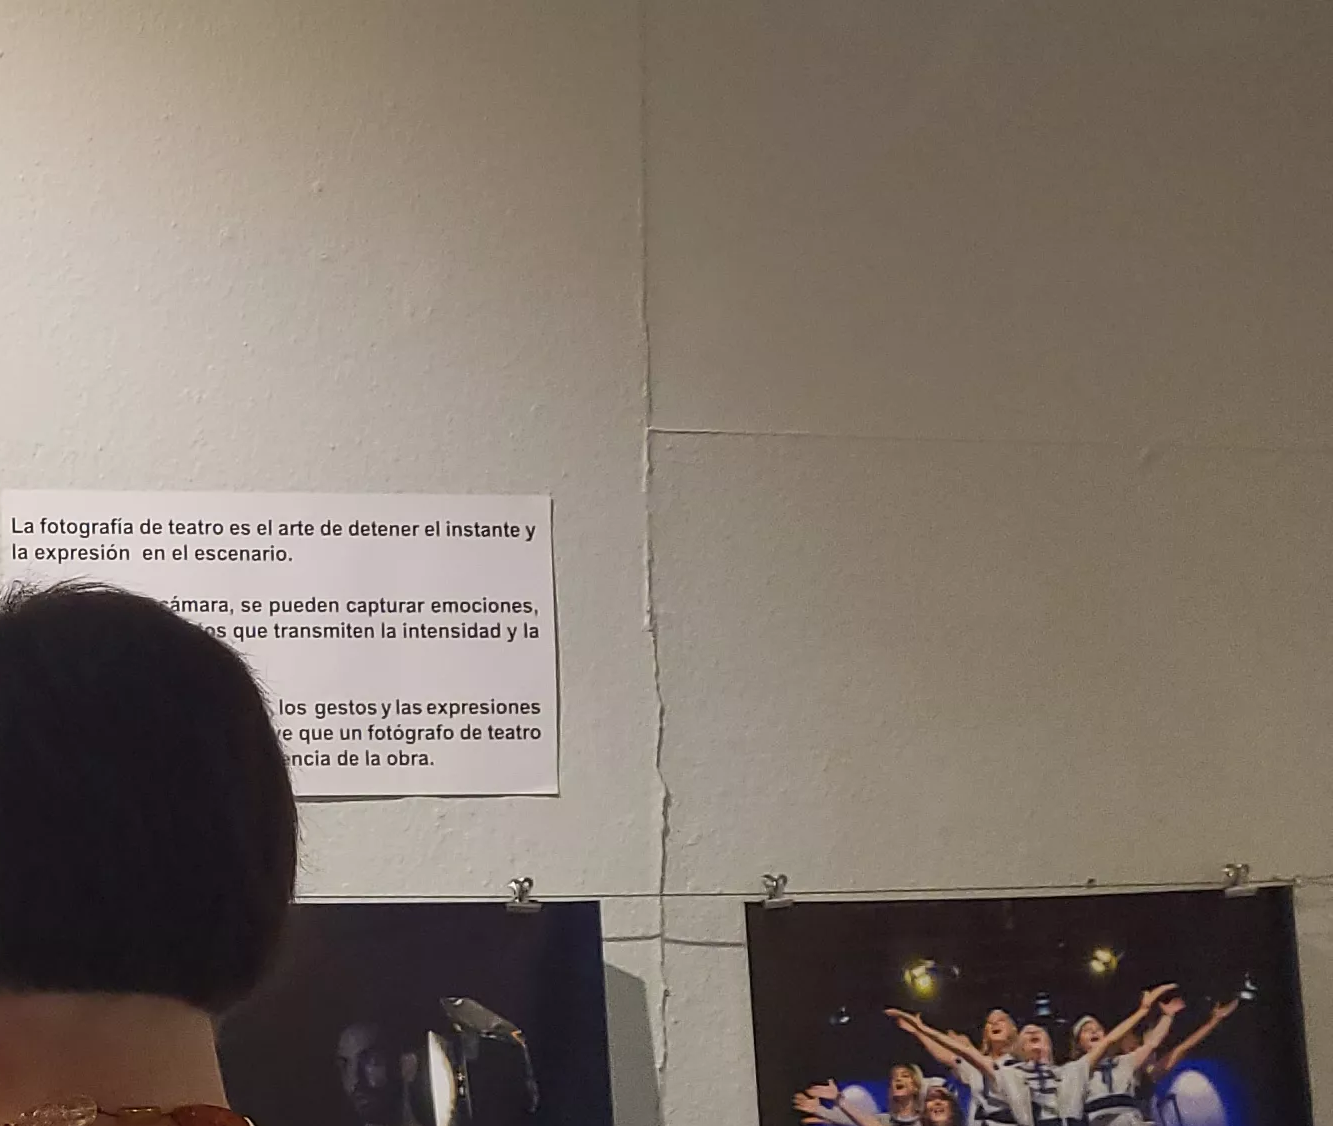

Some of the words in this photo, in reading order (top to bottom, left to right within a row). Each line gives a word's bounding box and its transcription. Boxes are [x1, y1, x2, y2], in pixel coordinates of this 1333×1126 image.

[11, 517, 35, 534] La
[39, 517, 134, 539] fotografía
[139, 518, 163, 535] de
[167, 519, 224, 536] teatro
[229, 523, 251, 536] es
[256, 519, 273, 537] el
[278, 519, 315, 537] arte
[319, 519, 343, 537] de
[348, 519, 421, 537] detener
[424, 520, 441, 538] el
[445, 520, 521, 539] instante
[524, 524, 537, 543] y
[12, 542, 29, 560] la
[34, 543, 130, 565] expresión
[142, 548, 166, 561] en
[171, 543, 188, 561] el
[194, 544, 293, 562] escenario.
[240, 600, 263, 613] se
[269, 596, 340, 617] pueden
[346, 597, 426, 618] capturar
[430, 596, 539, 617] emociones,
[233, 625, 268, 643] que
[273, 621, 375, 639] transmiten
[381, 621, 397, 639] la
[402, 621, 502, 639] intensidad
[506, 625, 518, 643] y
[523, 621, 540, 639] la
[278, 698, 307, 716] los
[314, 699, 378, 720] gestos
[380, 702, 392, 720] y
[395, 698, 423, 716] las
[426, 697, 542, 719] expresiones
[298, 728, 334, 745] que
[339, 727, 362, 741] un
[367, 723, 455, 745] fotógrafo
[459, 723, 483, 741] de
[487, 724, 542, 741] teatro
[282, 749, 331, 767] encia
[337, 749, 360, 767] de
[365, 749, 381, 767] la
[386, 749, 435, 767] obra.
